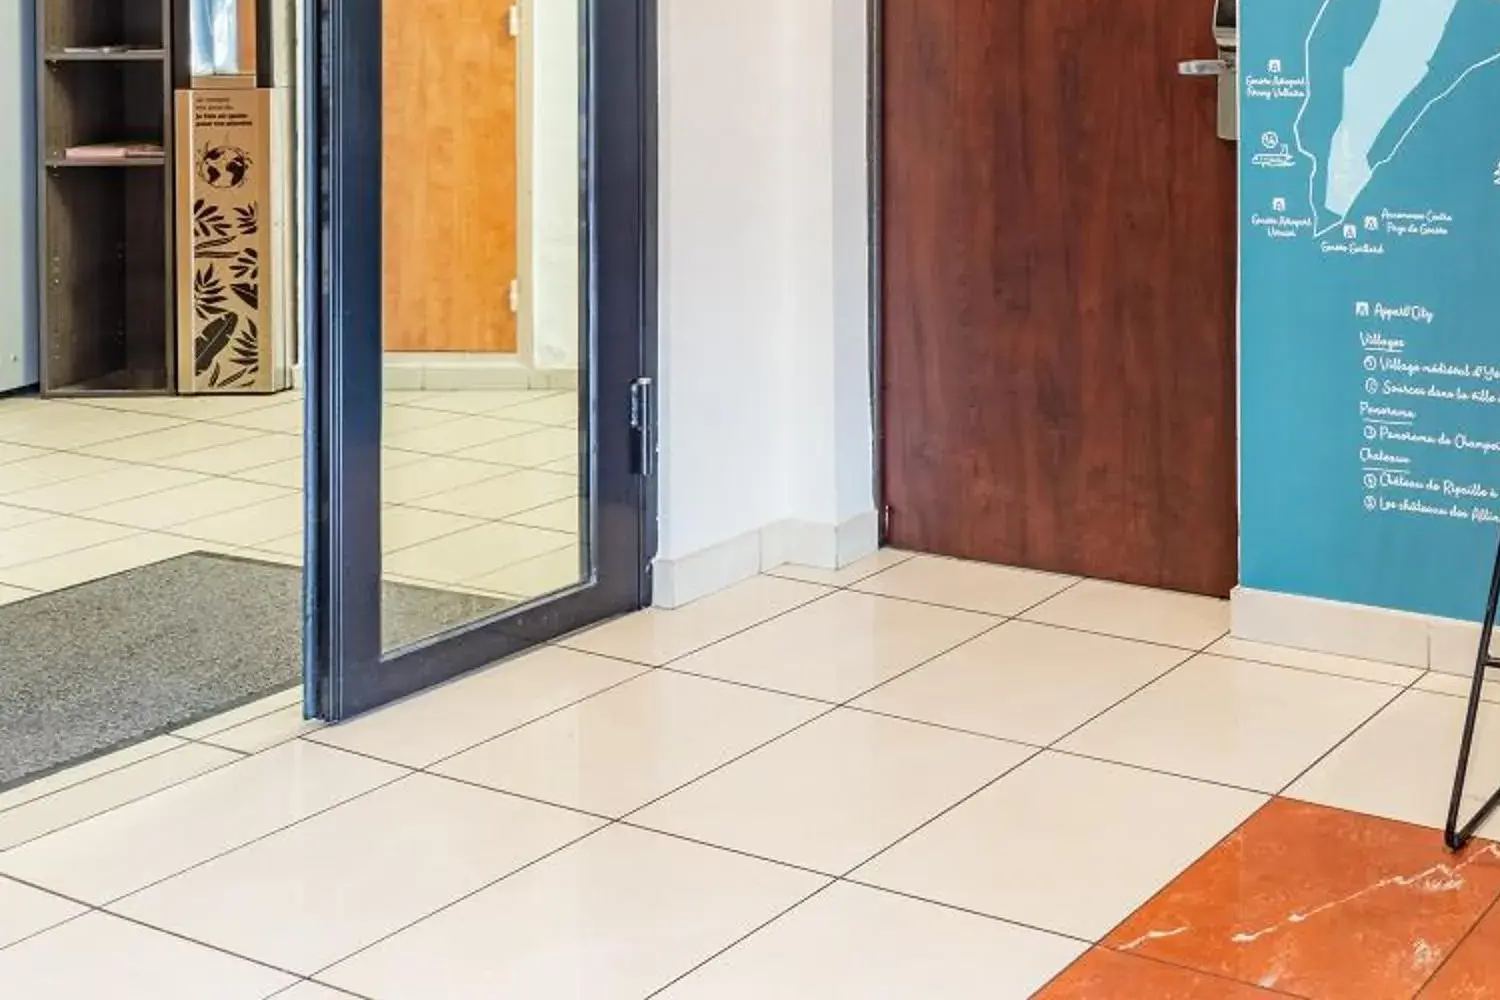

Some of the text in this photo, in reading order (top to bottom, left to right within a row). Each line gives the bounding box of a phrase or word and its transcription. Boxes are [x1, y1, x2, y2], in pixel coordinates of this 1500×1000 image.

[1379, 355, 1420, 376] Village
[1382, 379, 1425, 395] Sources
[1427, 384, 1455, 399] dans
[1456, 387, 1470, 400] la
[1360, 401, 1416, 418] Panorama
[1380, 425, 1436, 445] Panorama
[1438, 432, 1452, 445] de
[1426, 479, 1440, 492] de
[1379, 497, 1397, 511] Les
[1450, 504, 1468, 519] des
